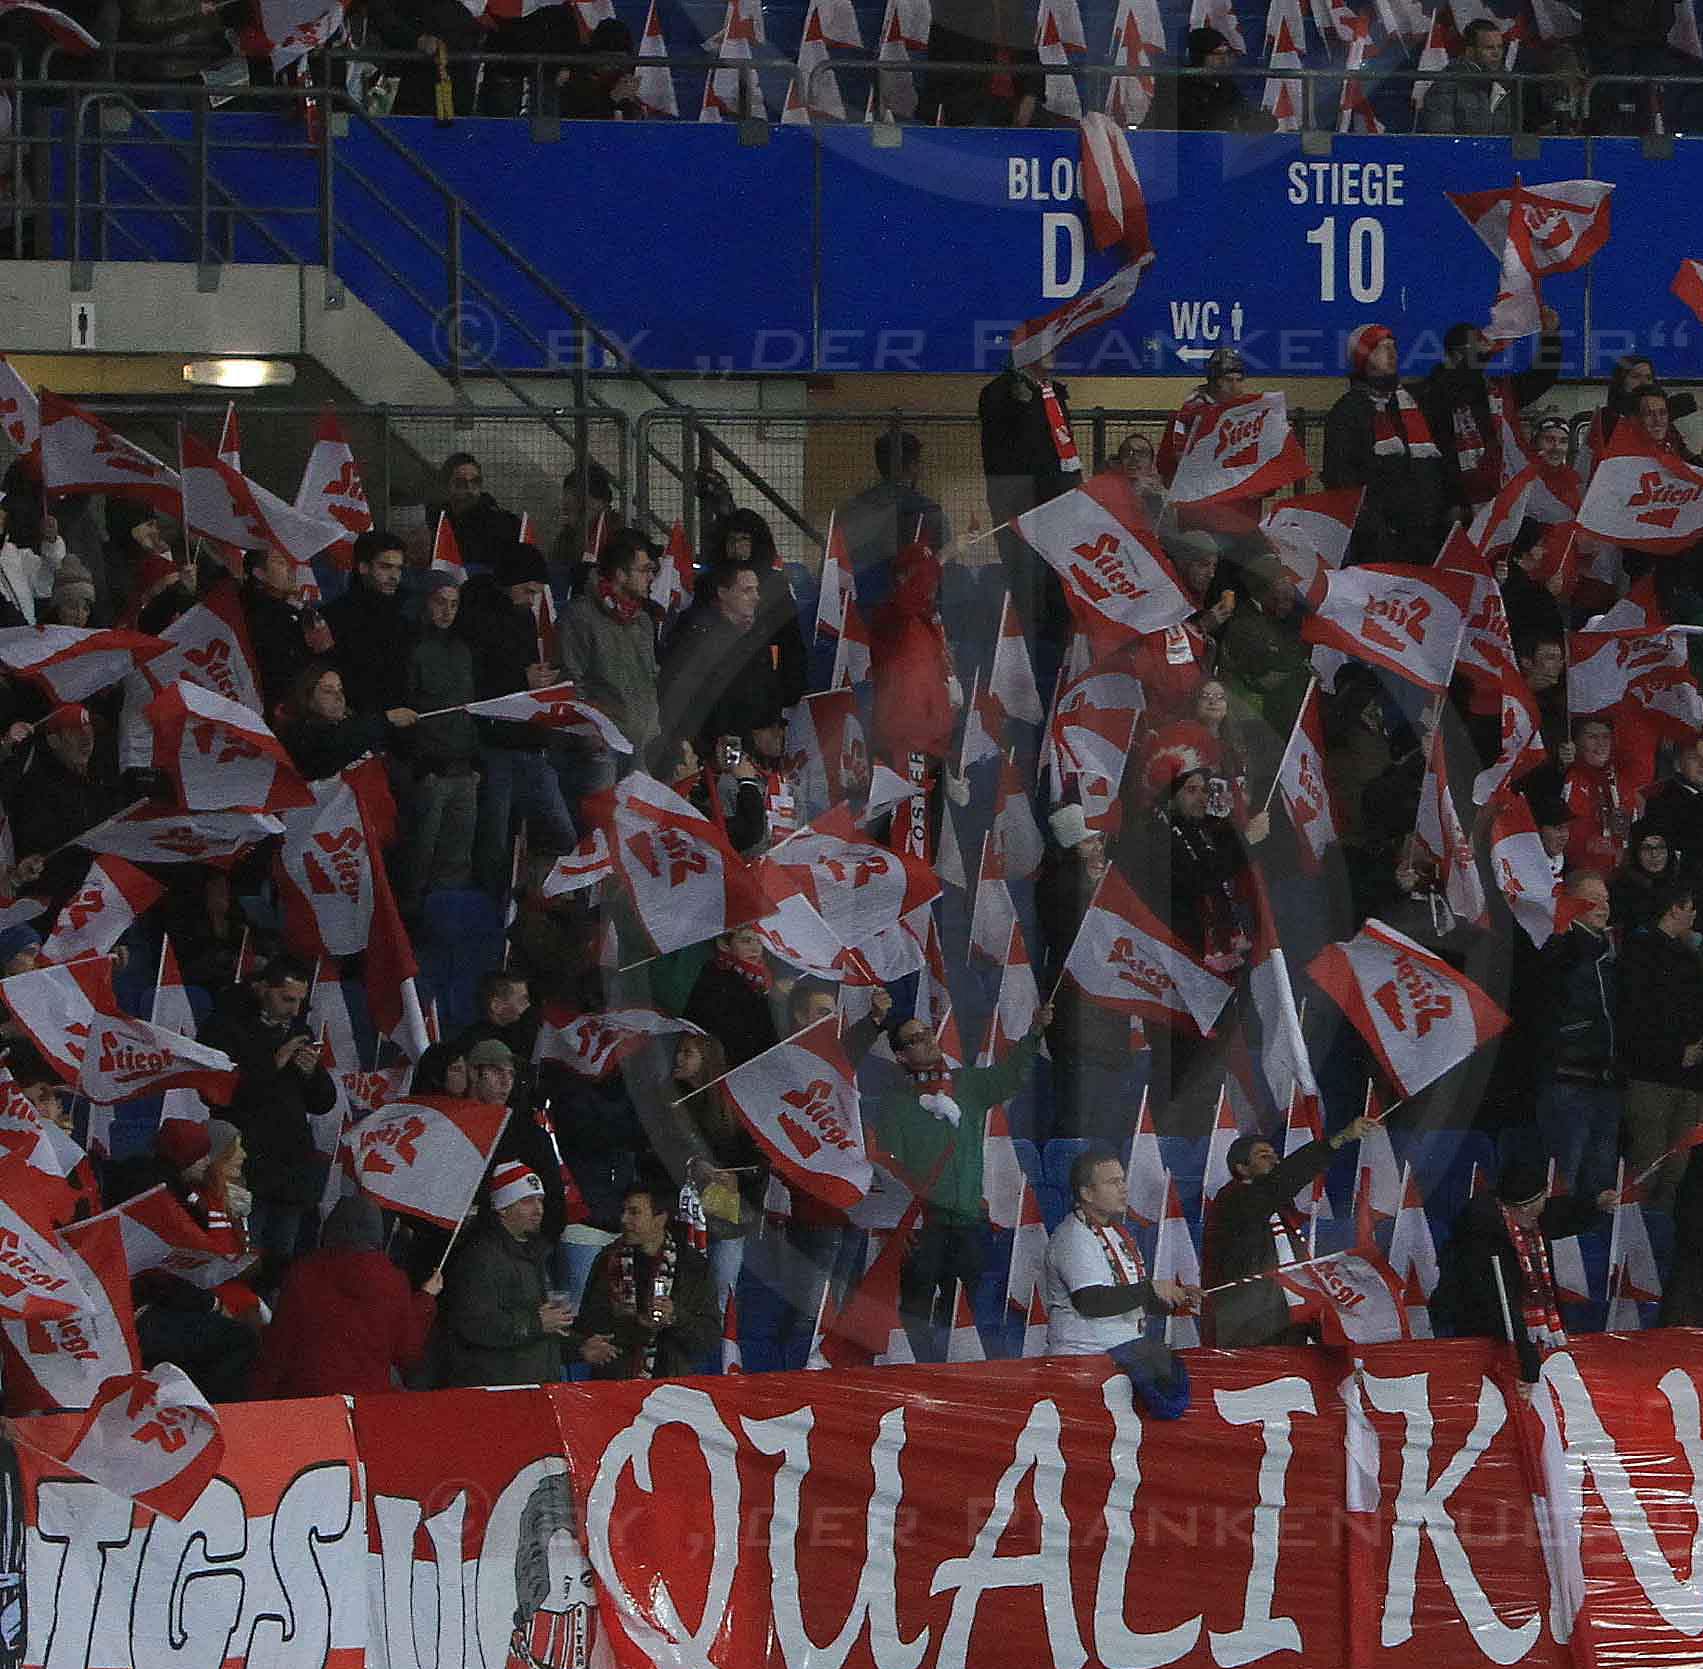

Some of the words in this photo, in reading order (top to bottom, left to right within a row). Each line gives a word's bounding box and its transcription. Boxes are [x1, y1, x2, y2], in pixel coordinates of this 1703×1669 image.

[1008, 157, 1084, 202] BLO
[1288, 162, 1405, 207] STIEGE
[1043, 211, 1086, 300] D
[1306, 217, 1387, 305] 10
[1169, 301, 1220, 341] WC
[1629, 470, 1703, 508] Stiegl
[1075, 531, 1146, 601] Stiegl
